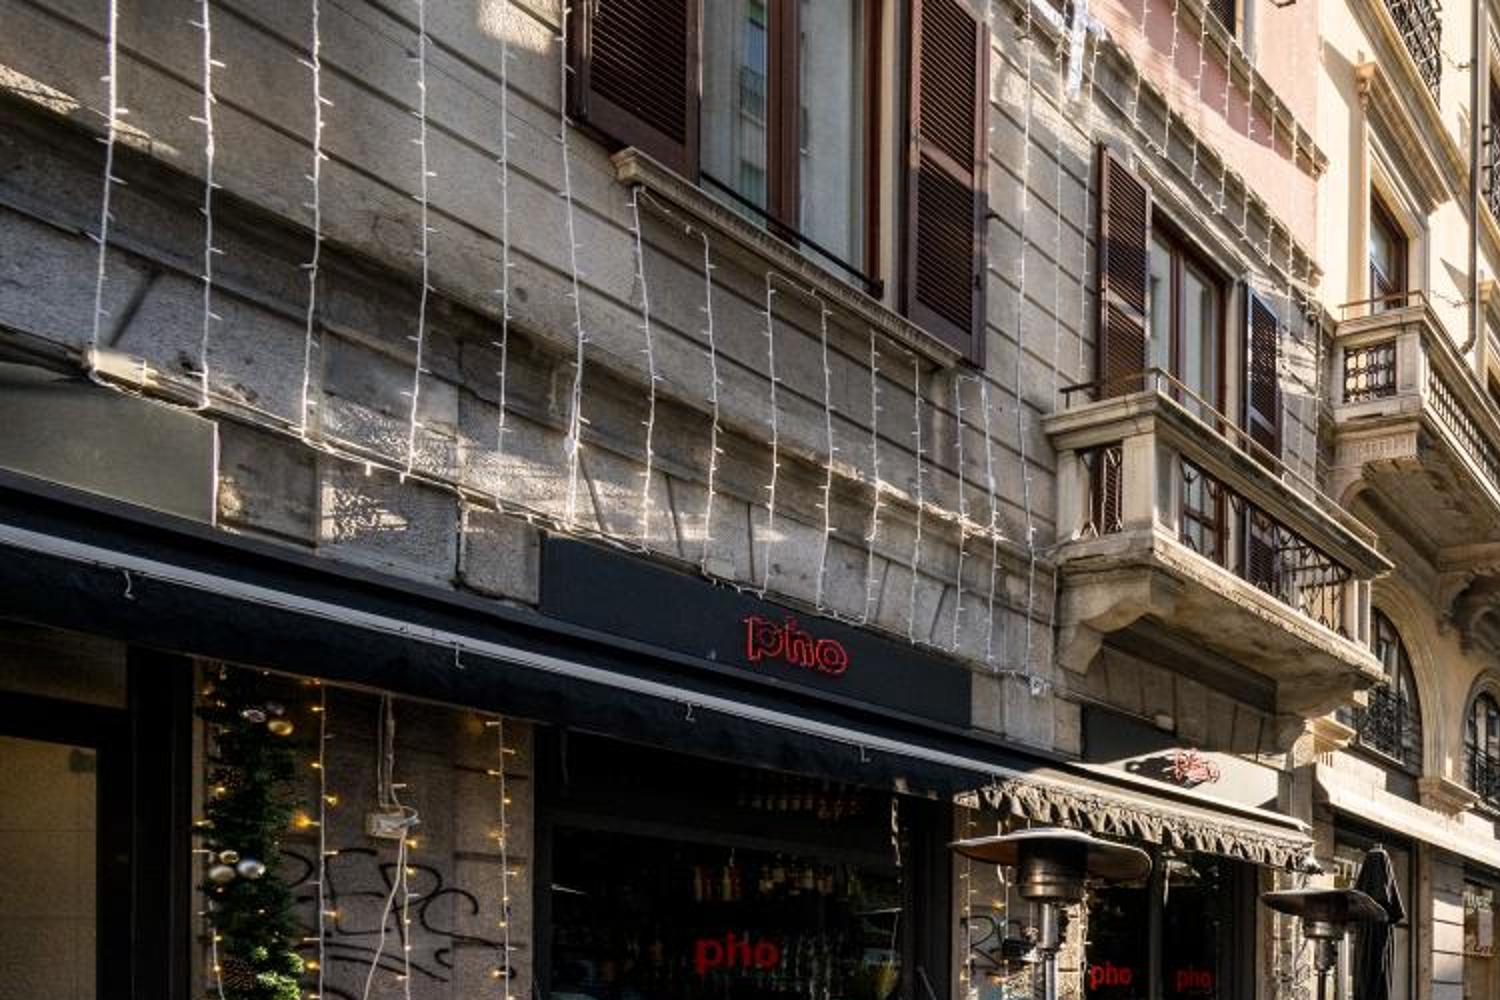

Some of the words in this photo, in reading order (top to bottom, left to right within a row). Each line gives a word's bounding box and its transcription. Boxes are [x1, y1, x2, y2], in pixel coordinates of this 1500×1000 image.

[743, 616, 849, 674] pho
[695, 928, 780, 976] pho
[1091, 961, 1132, 991] pho
